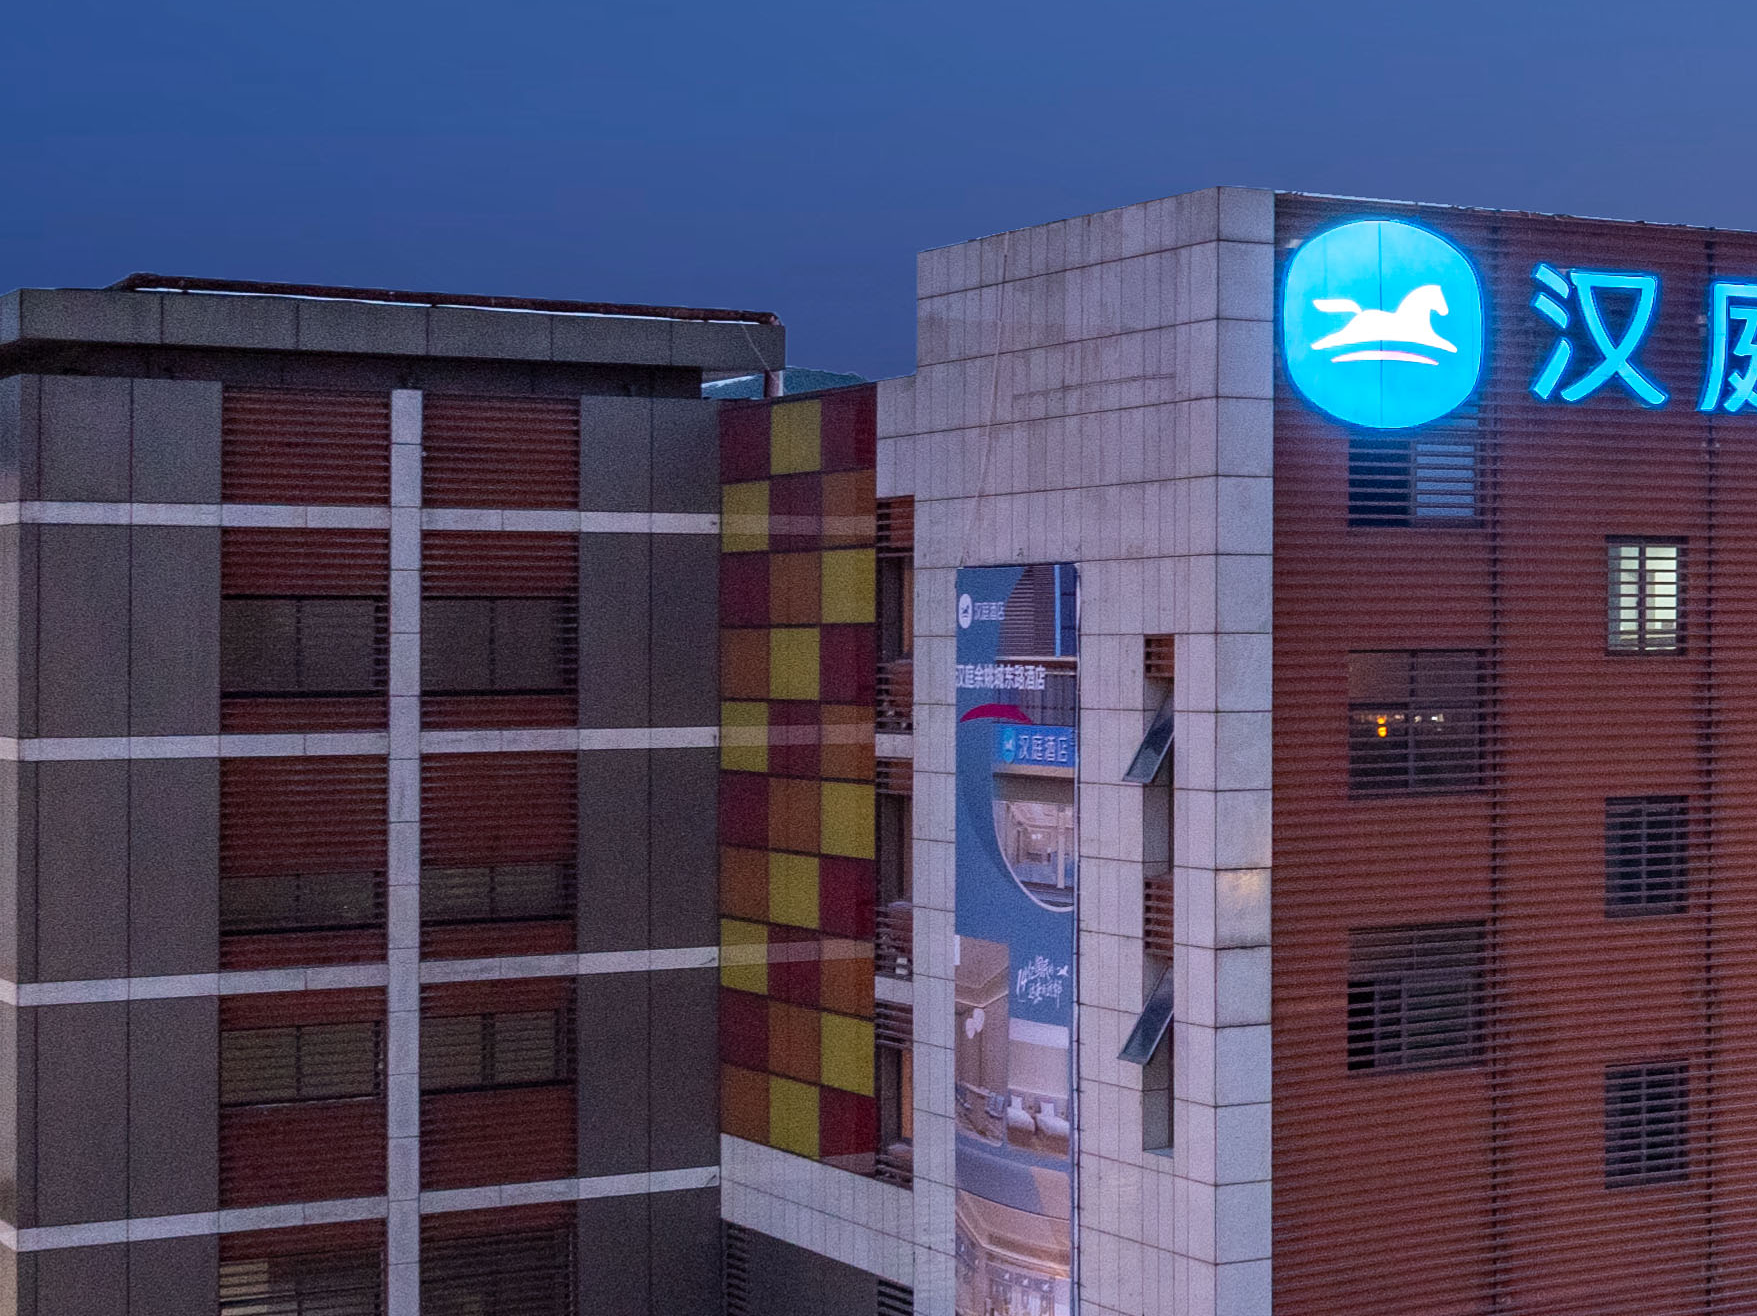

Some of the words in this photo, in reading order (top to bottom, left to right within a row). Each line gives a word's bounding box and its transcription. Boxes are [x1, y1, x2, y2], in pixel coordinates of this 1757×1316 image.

[974, 602, 1006, 621] 汉庭酒店
[1018, 734, 1068, 763] 汉庭酒店
